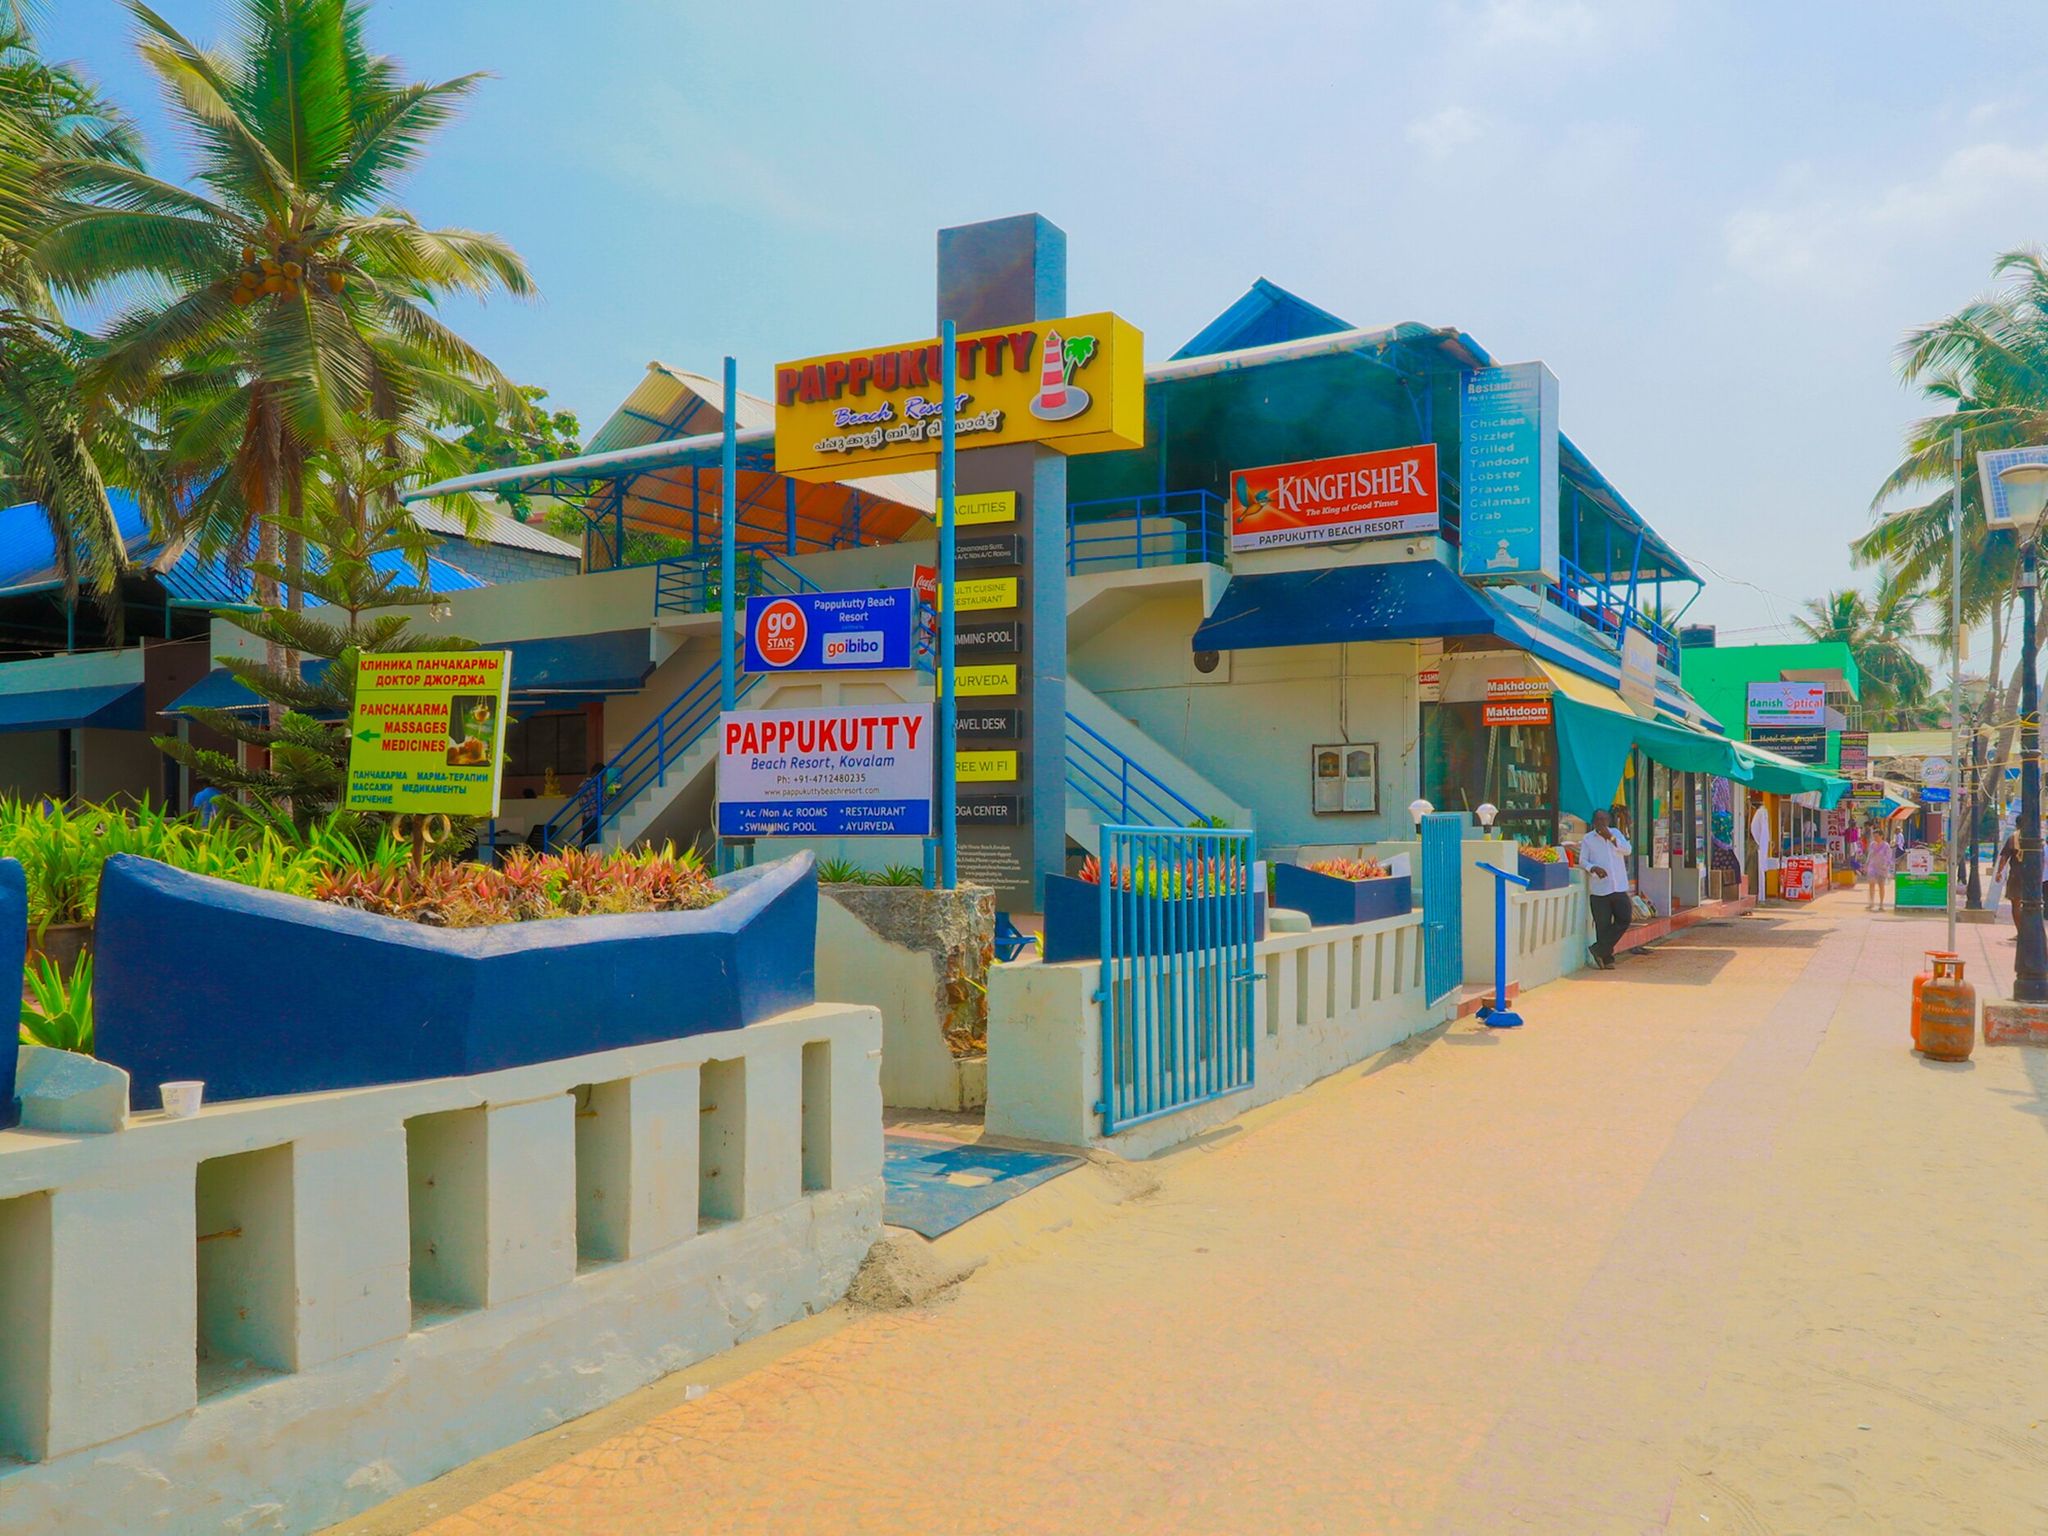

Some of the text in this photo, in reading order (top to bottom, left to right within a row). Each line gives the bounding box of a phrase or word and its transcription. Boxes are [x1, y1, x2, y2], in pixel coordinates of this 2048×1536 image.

[778, 331, 1036, 405] PAPPUKUTTY
[835, 394, 968, 426] Beach Resot
[1470, 418, 1525, 428] Chicken
[1470, 432, 1515, 441] Sizzler
[1470, 443, 1515, 455] Grilled
[1470, 456, 1529, 468] Tandoori
[1470, 471, 1521, 481] Lobster
[1277, 458, 1429, 513] KINGFISHER
[1470, 484, 1520, 494] Prawns
[1321, 507, 1340, 515] King
[1350, 503, 1372, 511] Good
[1373, 500, 1399, 508] Times
[1470, 497, 1530, 508] Calamari
[955, 502, 1007, 516] CILITIES
[1470, 511, 1501, 521] Crab
[1259, 529, 1325, 545] PAPPUKUTTY
[1328, 525, 1362, 537] BEACH
[1364, 520, 1404, 533] RESORT
[955, 583, 1007, 595] ULTI CUISINE
[814, 595, 895, 612] Pappukutty Beach
[954, 595, 1003, 606] ESTAURANT
[839, 612, 869, 623] Resort
[766, 611, 797, 638] go
[767, 637, 795, 649] STAYS
[986, 631, 1012, 643] POOL
[827, 638, 879, 657] goibibo
[360, 659, 499, 671] КЛИНИКА ПАНЧАКАРМЫ
[376, 674, 486, 687] ДОКТОР ДЖОРДЖА
[954, 674, 1008, 687] YURVEDA
[1487, 681, 1549, 692] Makhdoom
[1749, 697, 1823, 709] danish Optical
[360, 703, 449, 716] PANCHAKARMA
[1486, 705, 1548, 717] Makhdoom
[384, 721, 447, 734] MASSAGES
[955, 717, 1006, 730] RAVEL DESK
[726, 715, 923, 755] PAPPUKUTTY
[382, 739, 446, 752] MEDICINES
[751, 754, 895, 770] Beach Resort, Kovalam
[955, 760, 1008, 772] REE WI FI
[777, 773, 866, 784] Ph: +91-4712480235
[352, 783, 393, 792] МАССАЖИ
[745, 808, 756, 818] Ac
[782, 808, 793, 818] Ac
[795, 807, 828, 817] ROOMS
[845, 806, 907, 817] RESTAURANT
[955, 805, 1008, 817] OGA CENTER
[745, 822, 817, 832] SWIMMING POOL
[845, 821, 895, 831] AYURVEDA
